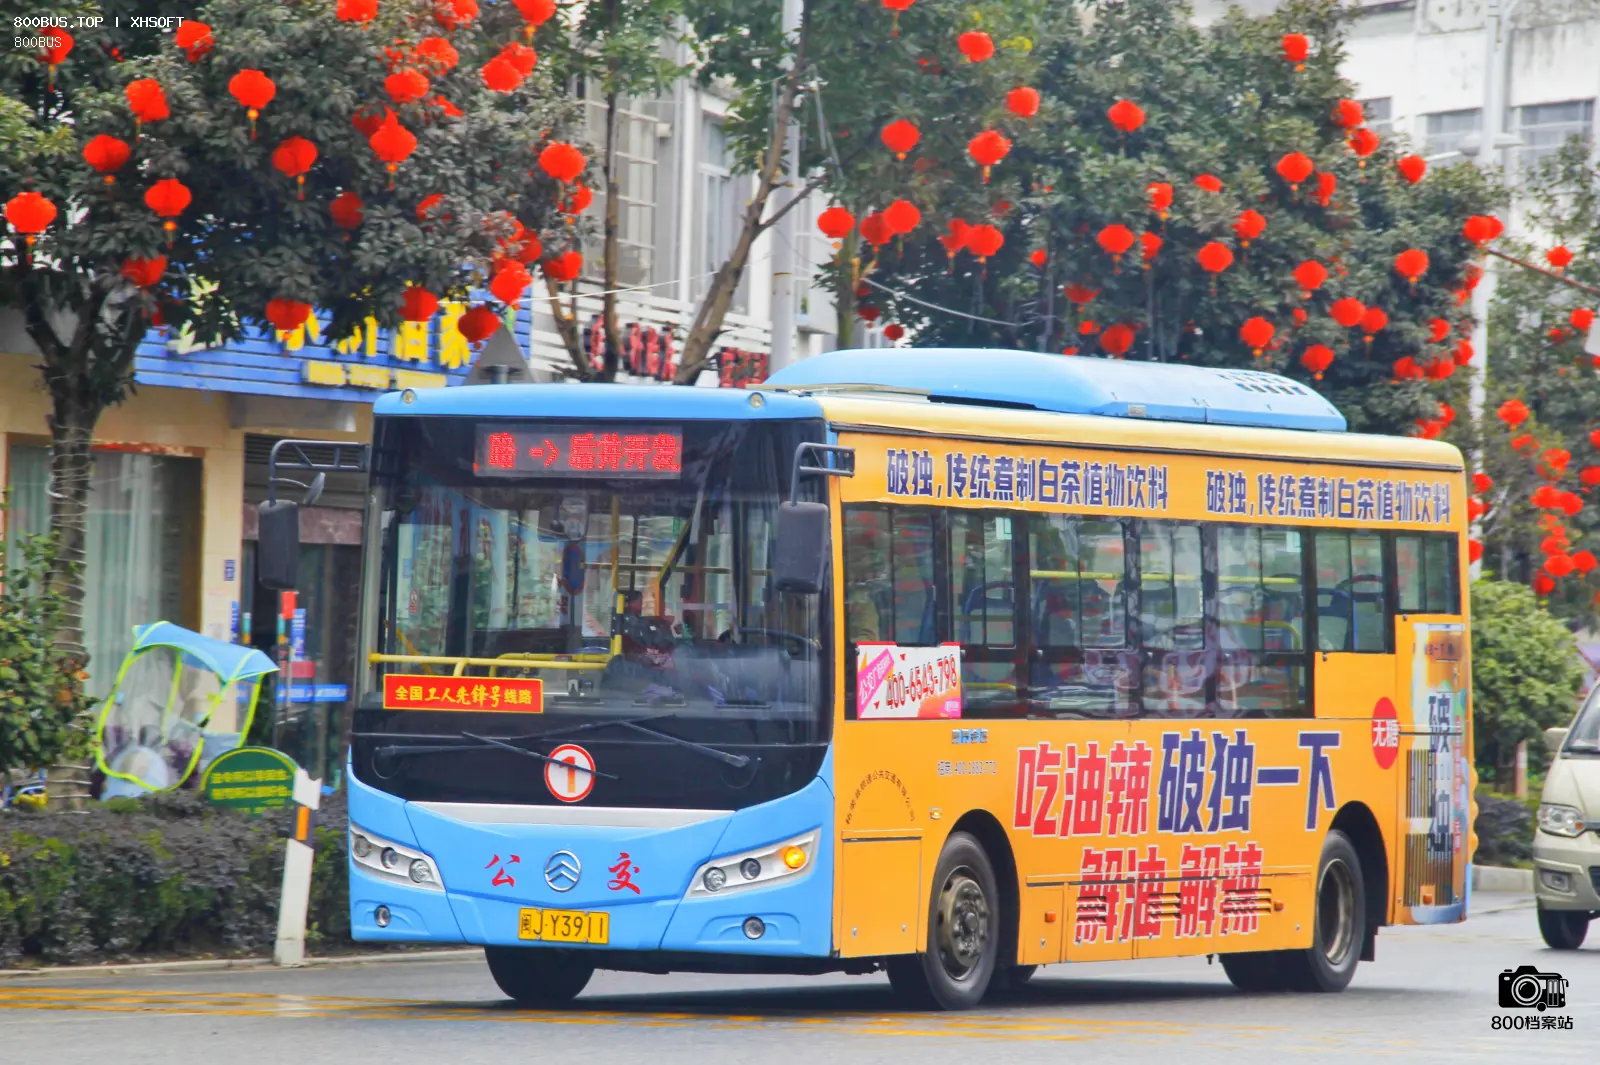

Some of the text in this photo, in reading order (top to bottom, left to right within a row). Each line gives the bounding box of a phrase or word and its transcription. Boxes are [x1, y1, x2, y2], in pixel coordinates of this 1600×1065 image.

[395, 684, 532, 708] 全国工人先锋号线路
[886, 654, 957, 709] 400-6543-798
[559, 756, 576, 793] 1
